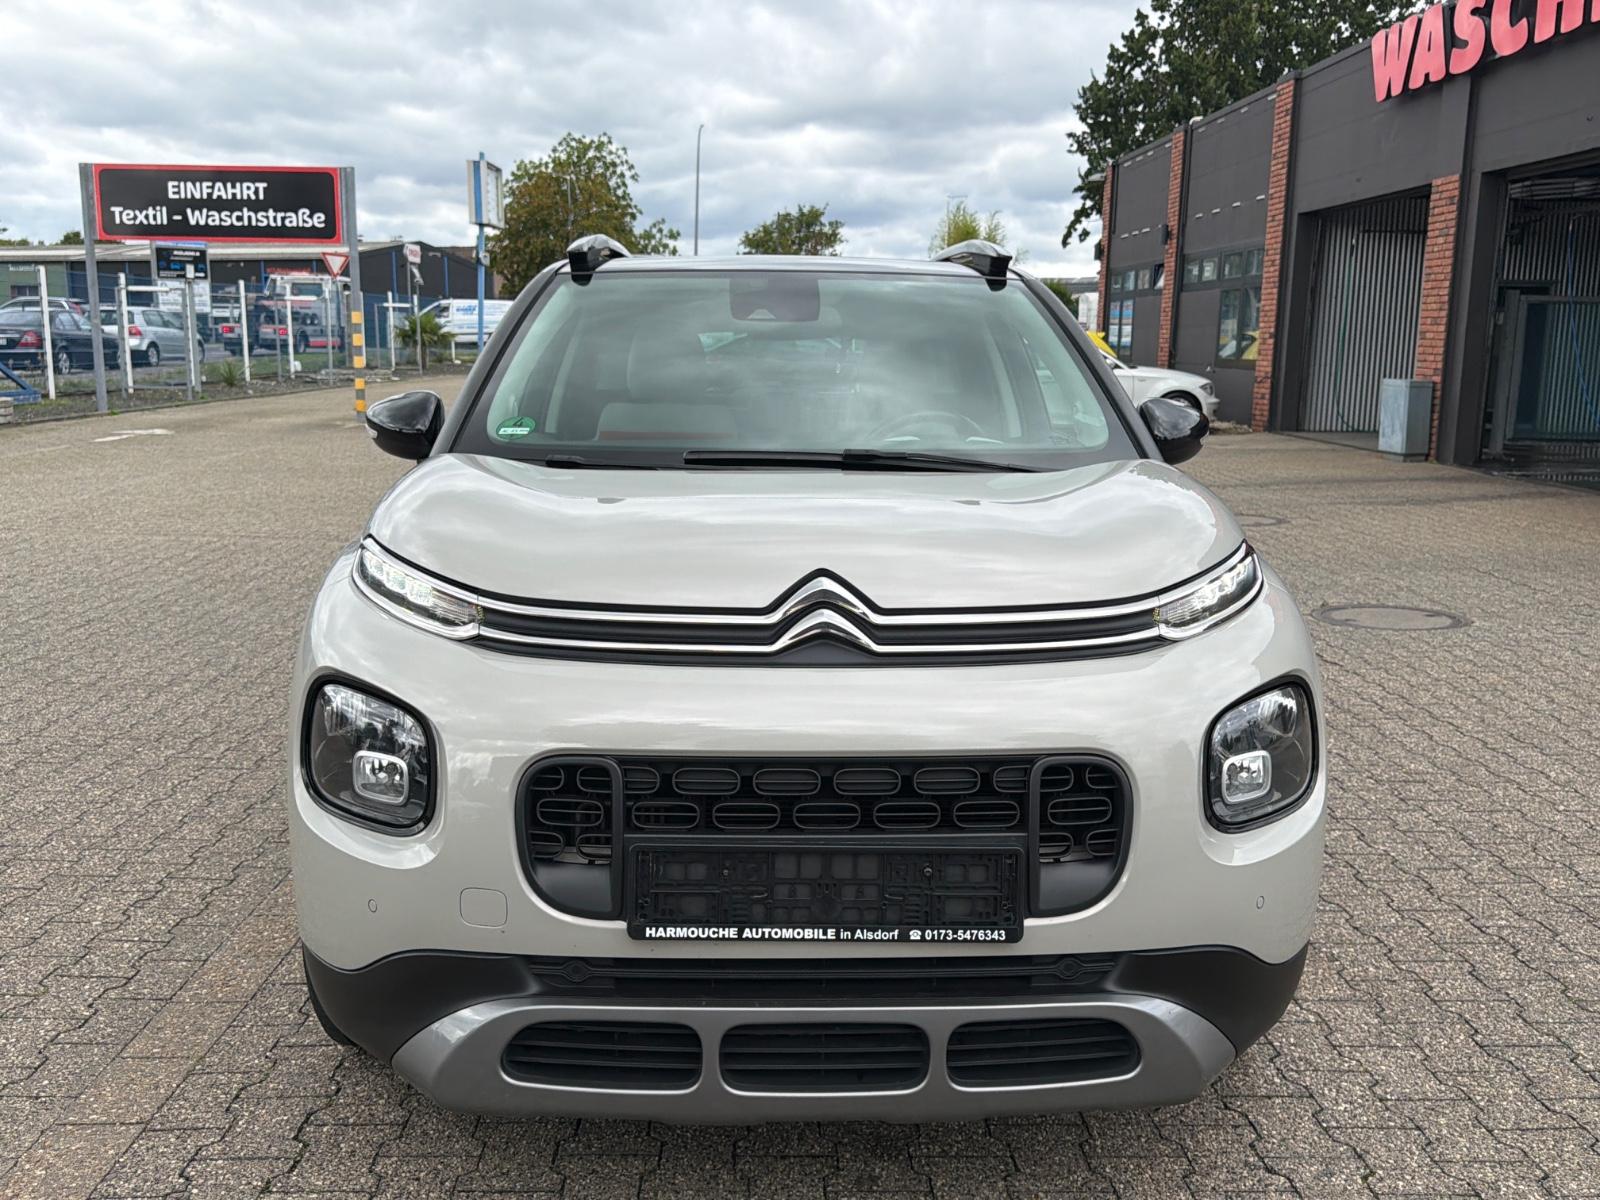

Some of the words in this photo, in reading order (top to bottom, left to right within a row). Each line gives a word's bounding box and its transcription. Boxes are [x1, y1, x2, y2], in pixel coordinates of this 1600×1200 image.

[1371, 0, 1600, 103] WASCH
[166, 180, 268, 201] EINFAHRT
[110, 206, 168, 226] Textil
[185, 207, 326, 229] Waschstraße
[645, 926, 739, 940] HARMOUCHE
[741, 927, 837, 941] AUTOMOBILE
[840, 928, 852, 940] in
[853, 928, 900, 941] Alsdorf
[924, 929, 1006, 942] 0173-5476343
